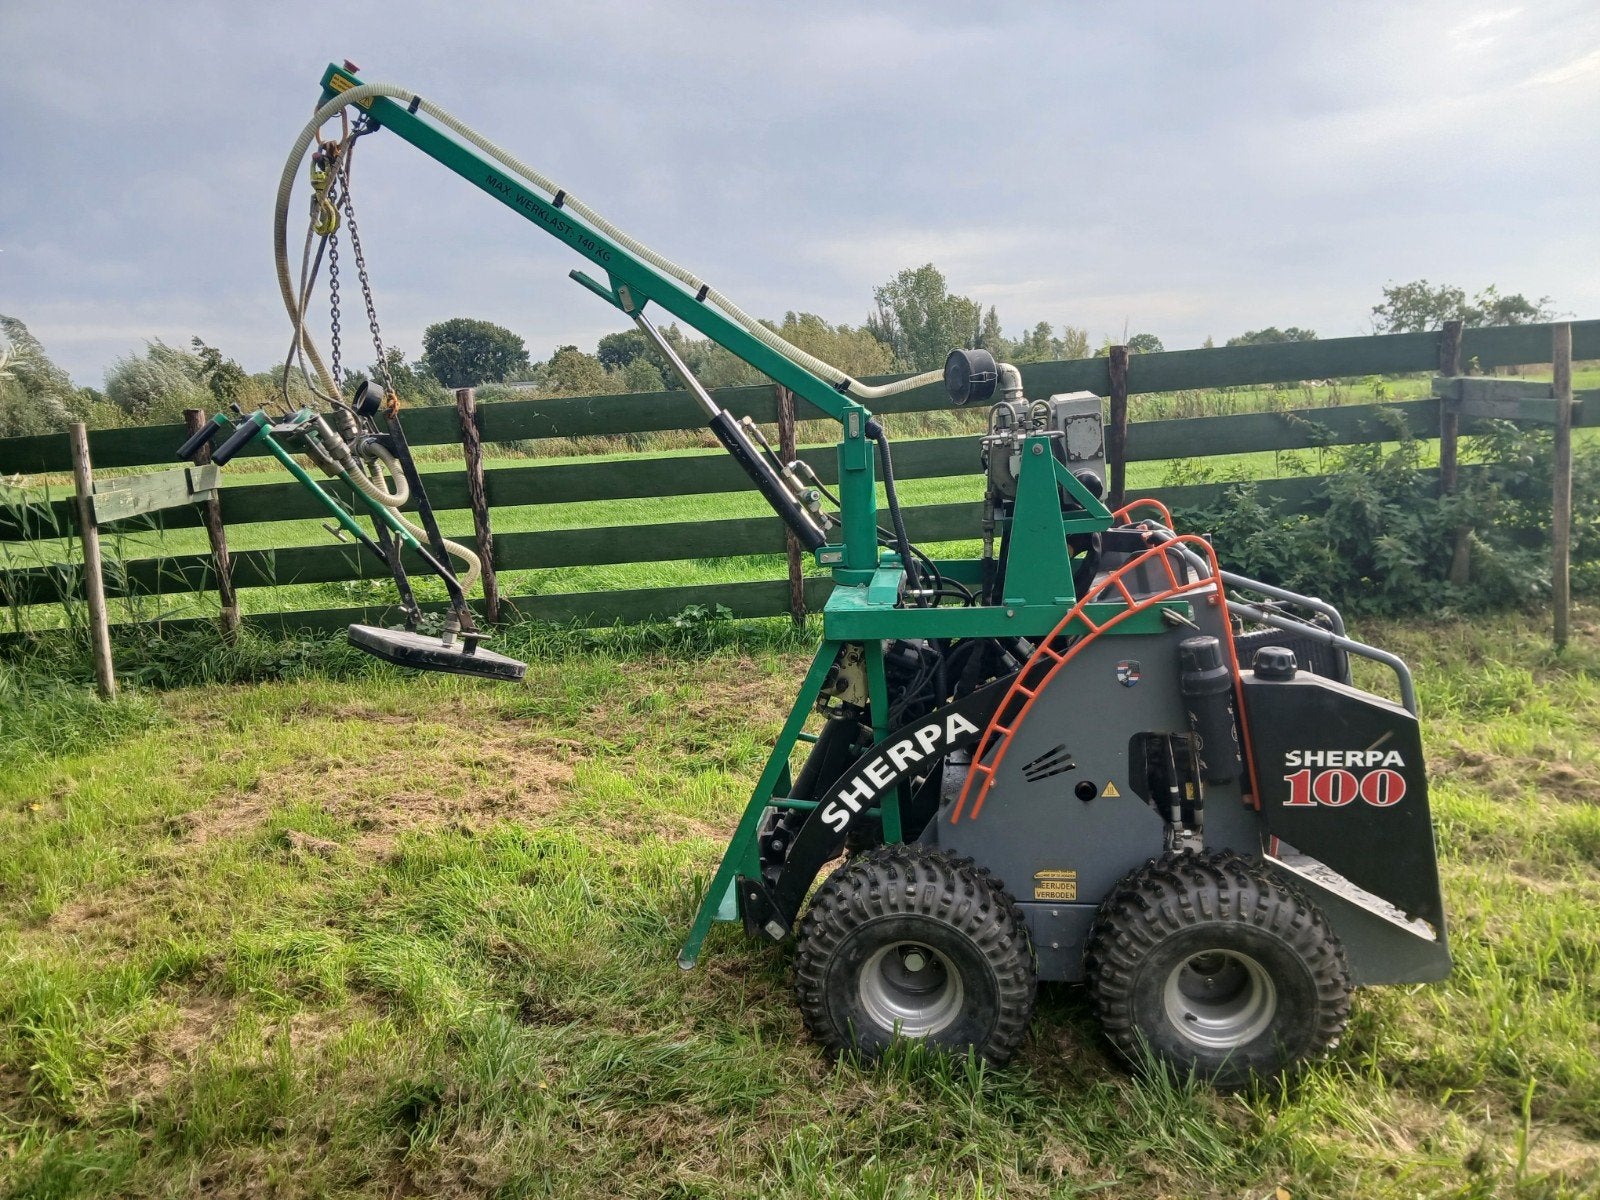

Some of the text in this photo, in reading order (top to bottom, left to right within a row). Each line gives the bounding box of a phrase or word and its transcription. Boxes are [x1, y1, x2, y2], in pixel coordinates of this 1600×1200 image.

[486, 175, 511, 199] MAX.
[578, 234, 594, 251] 140
[595, 247, 612, 262] KG
[821, 712, 980, 833] SHERPA
[1285, 750, 1405, 767] SHERPA
[1283, 769, 1407, 807] 100
[1036, 891, 1075, 899] VERBODEN
